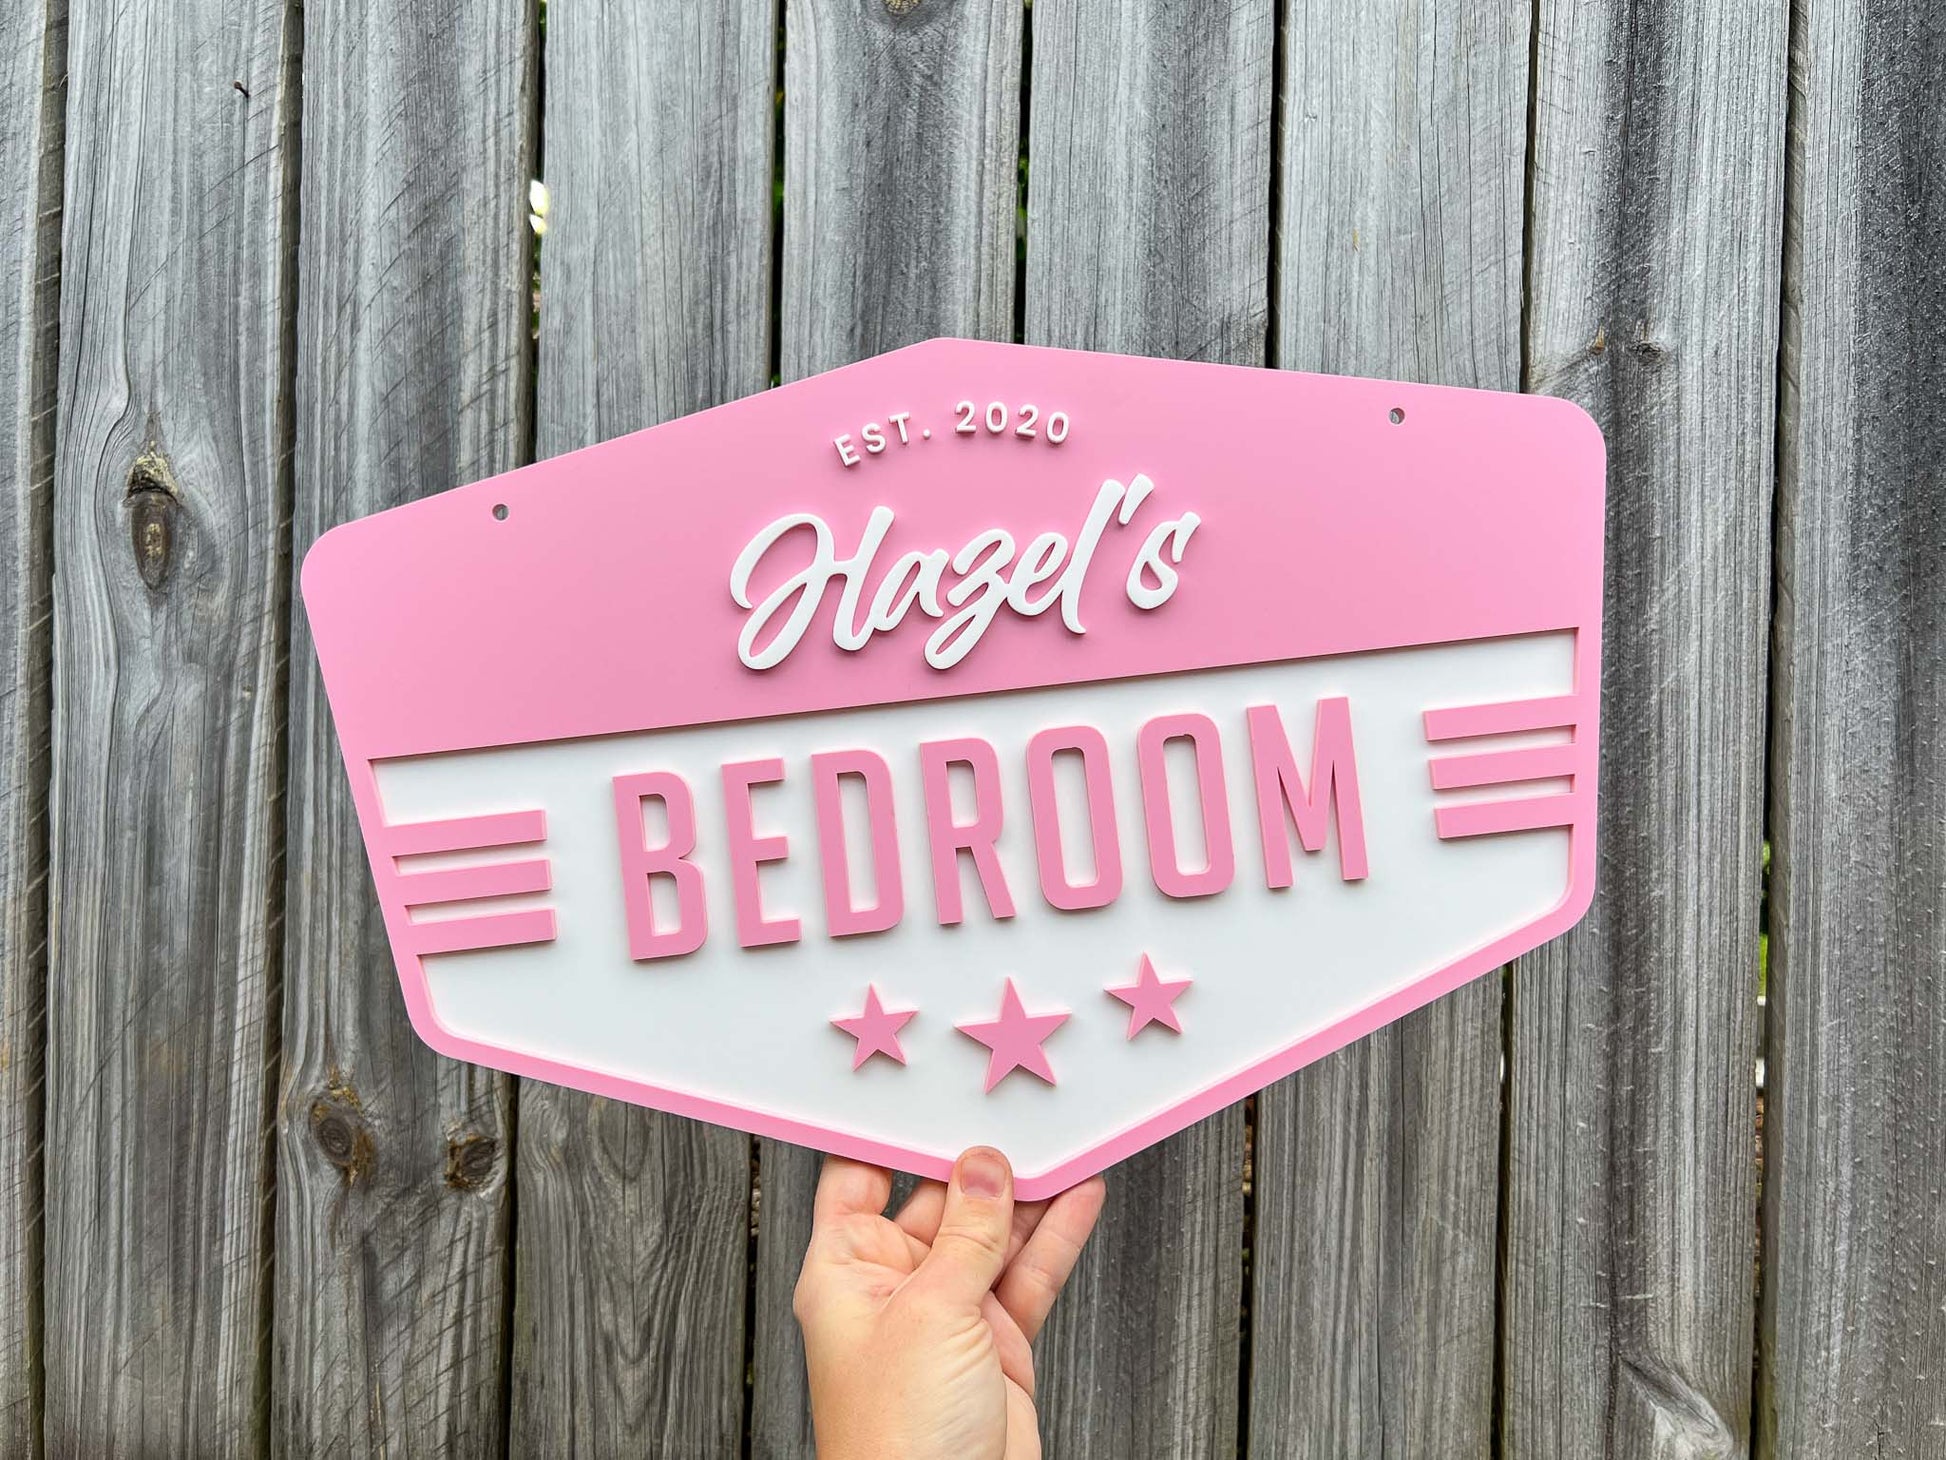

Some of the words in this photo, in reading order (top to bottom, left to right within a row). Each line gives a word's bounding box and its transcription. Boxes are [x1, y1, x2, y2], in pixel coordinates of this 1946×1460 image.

[833, 412, 931, 467] EST.
[955, 401, 1069, 444] 2020
[730, 474, 1201, 670] Hazel's
[612, 696, 1369, 961] BEDROOM
